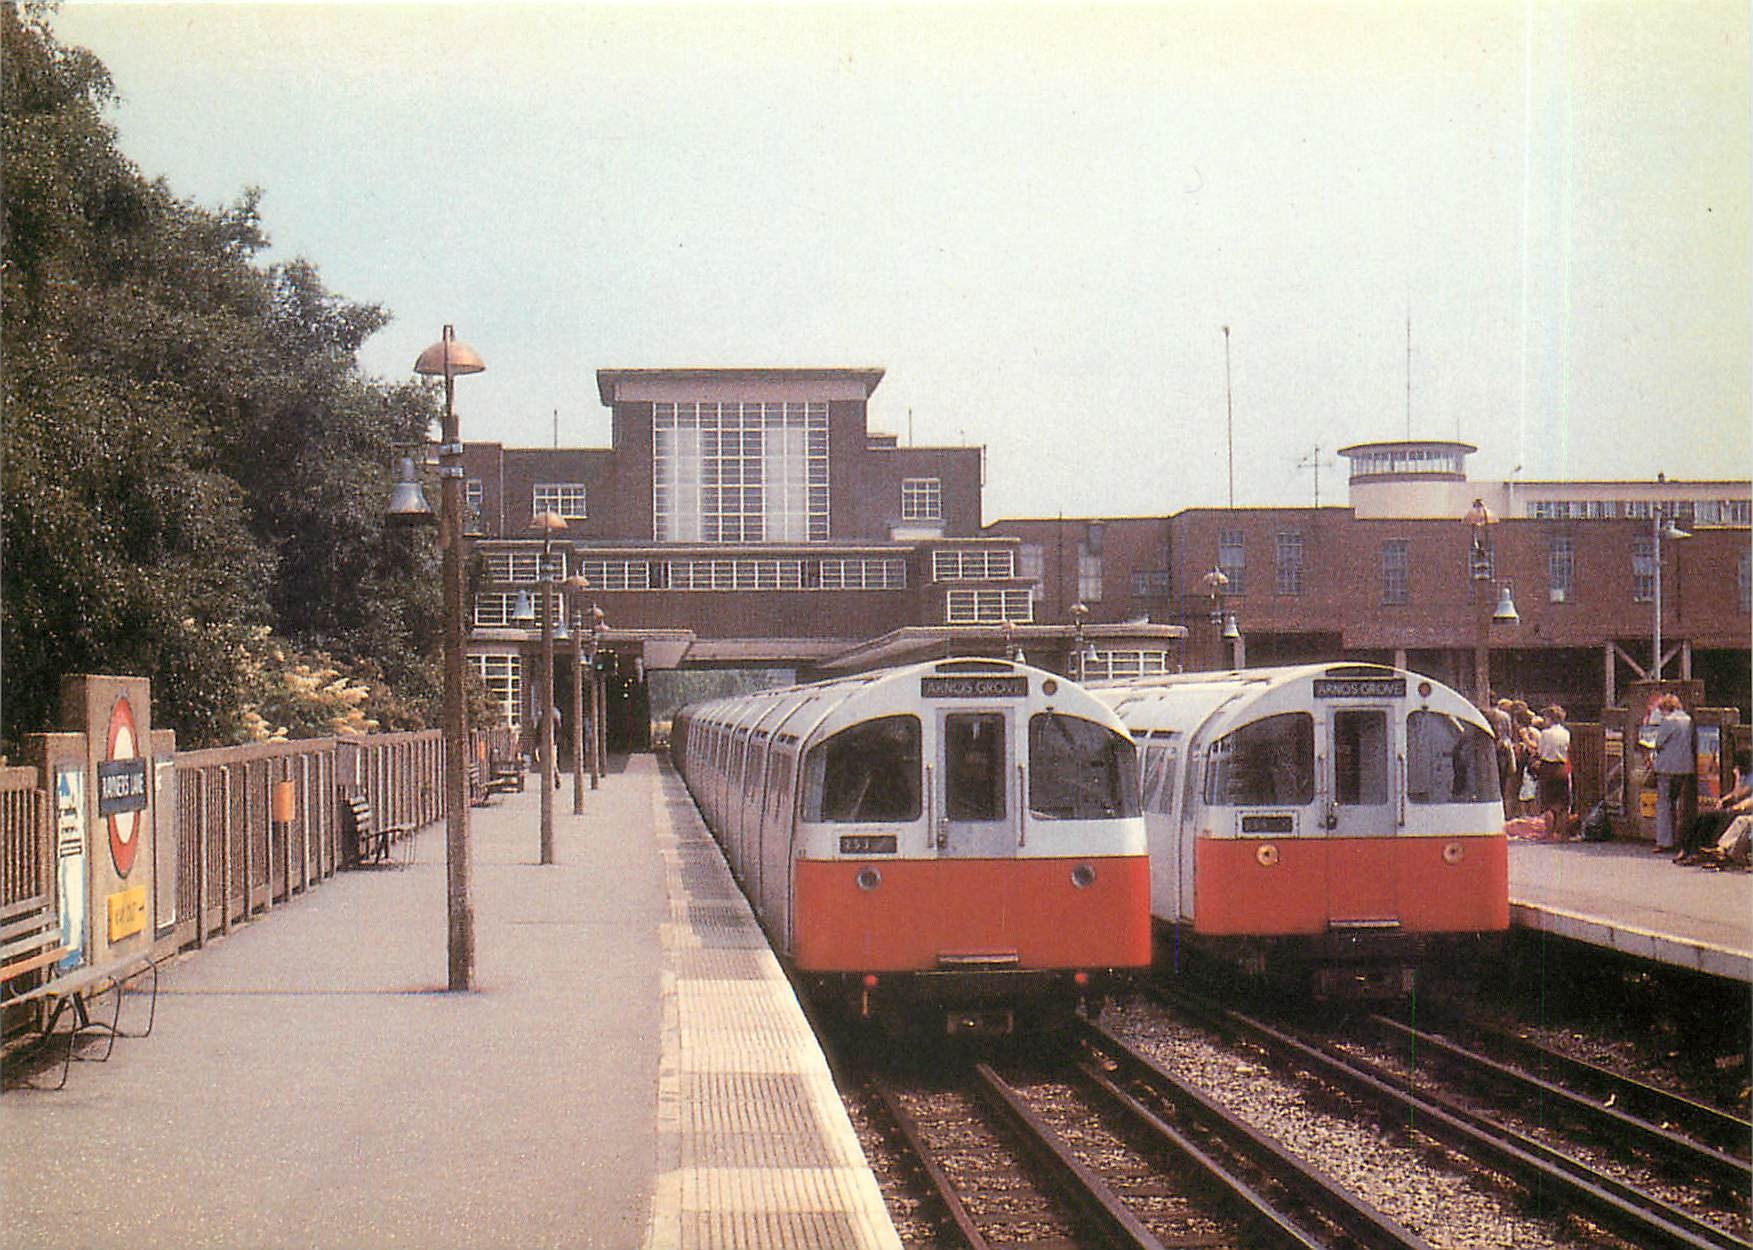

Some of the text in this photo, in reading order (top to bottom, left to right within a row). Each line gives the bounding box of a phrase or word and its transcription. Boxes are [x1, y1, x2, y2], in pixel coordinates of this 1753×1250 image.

[1361, 682, 1403, 695] GROVE
[102, 773, 144, 799] RAYNERS LANE
